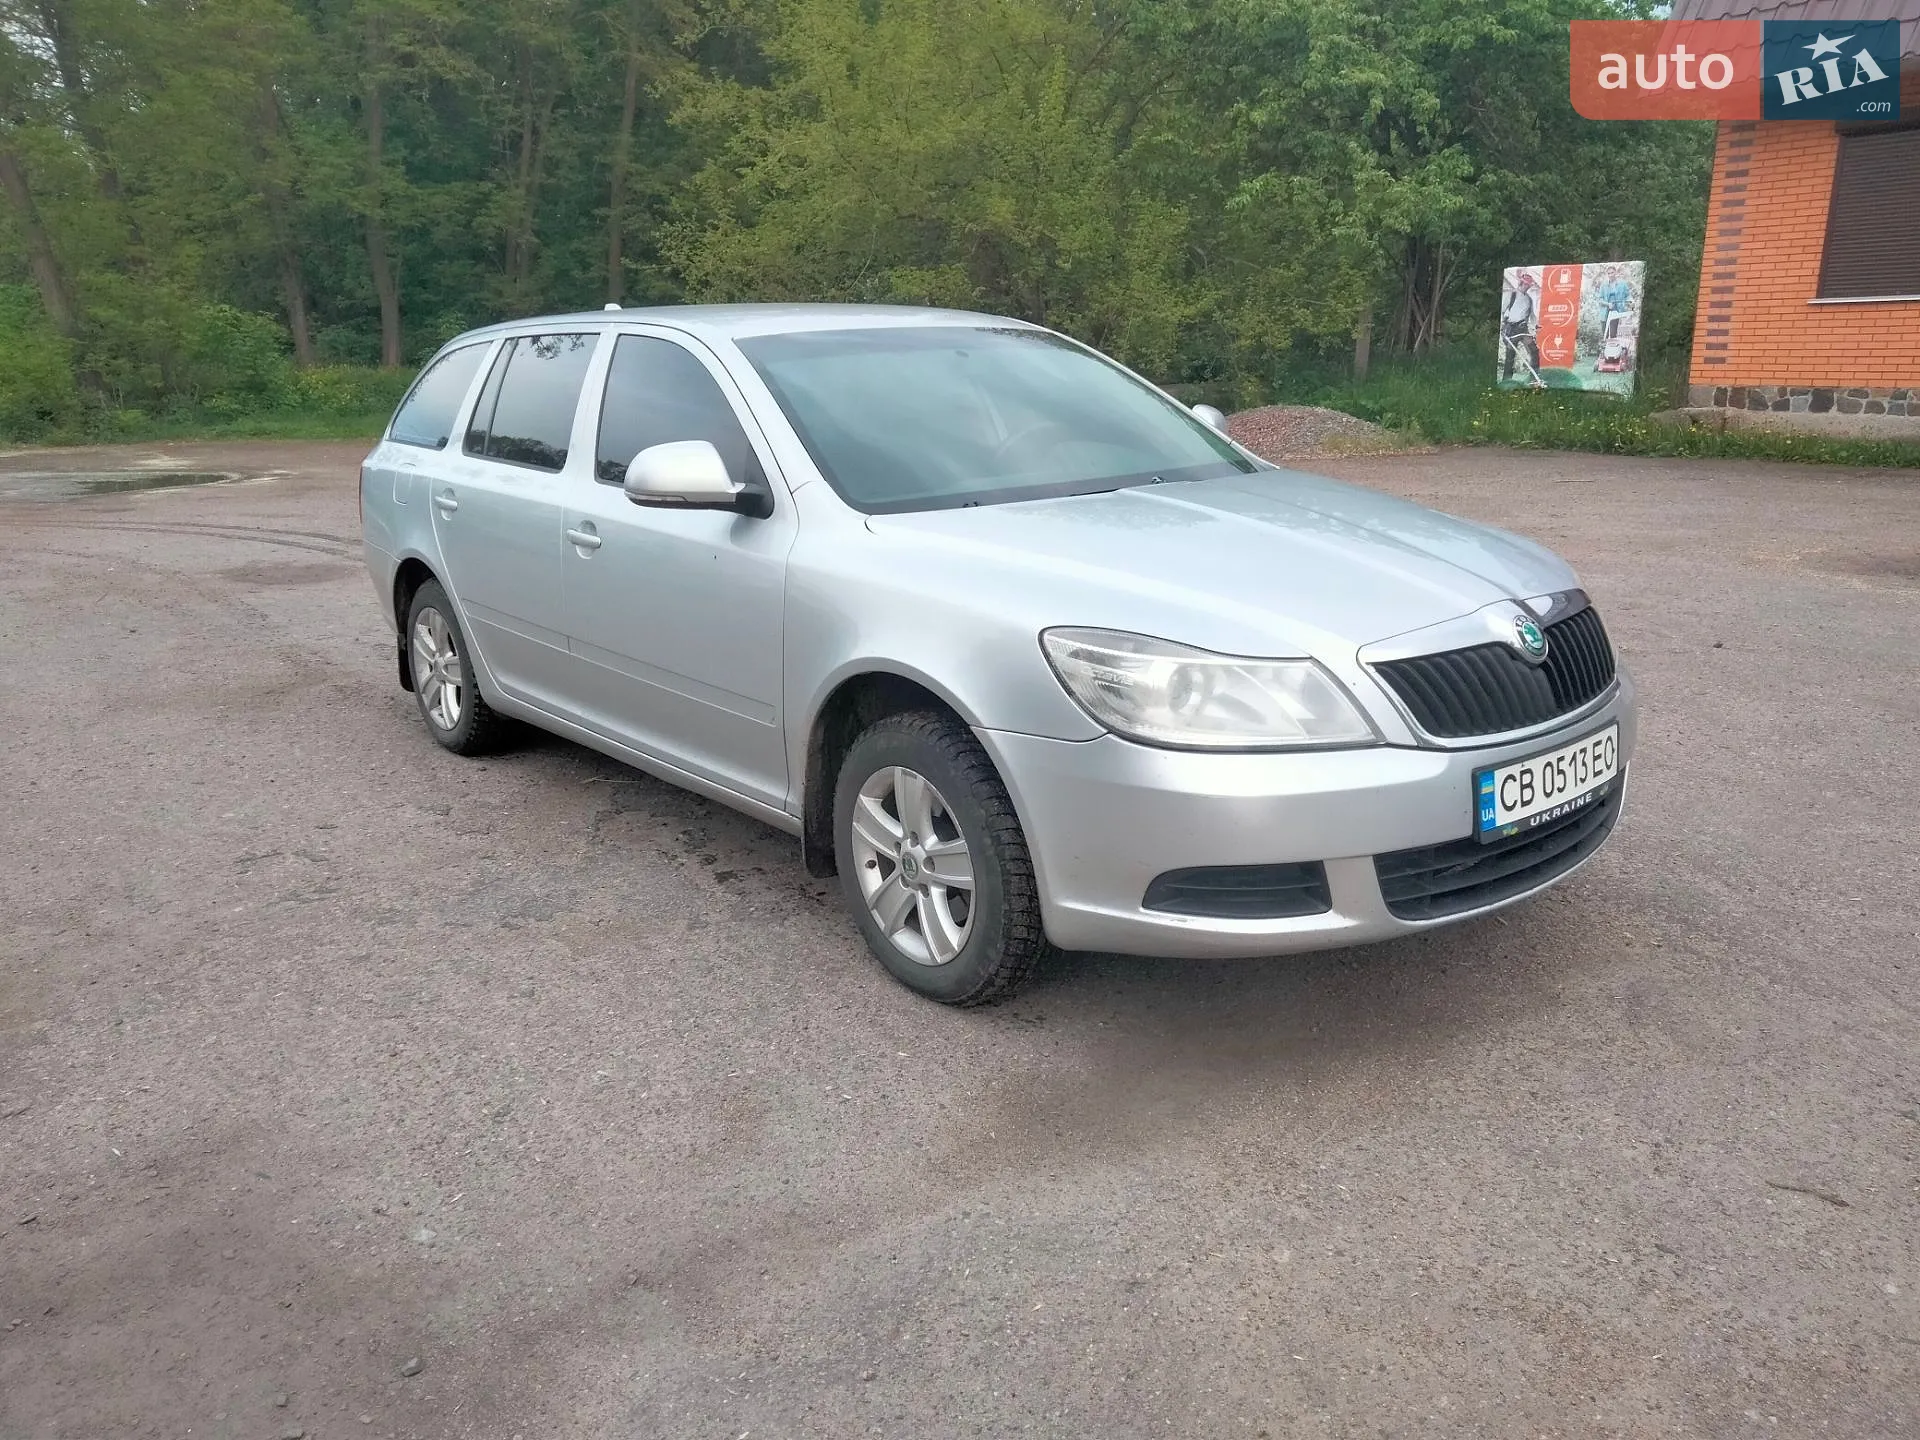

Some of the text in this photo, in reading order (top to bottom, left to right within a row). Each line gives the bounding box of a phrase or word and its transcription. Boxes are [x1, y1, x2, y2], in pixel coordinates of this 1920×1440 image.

[1500, 735, 1615, 812] CB 0513 EO
[1482, 808, 1495, 822] UA
[1530, 792, 1593, 826] UKRAINE
